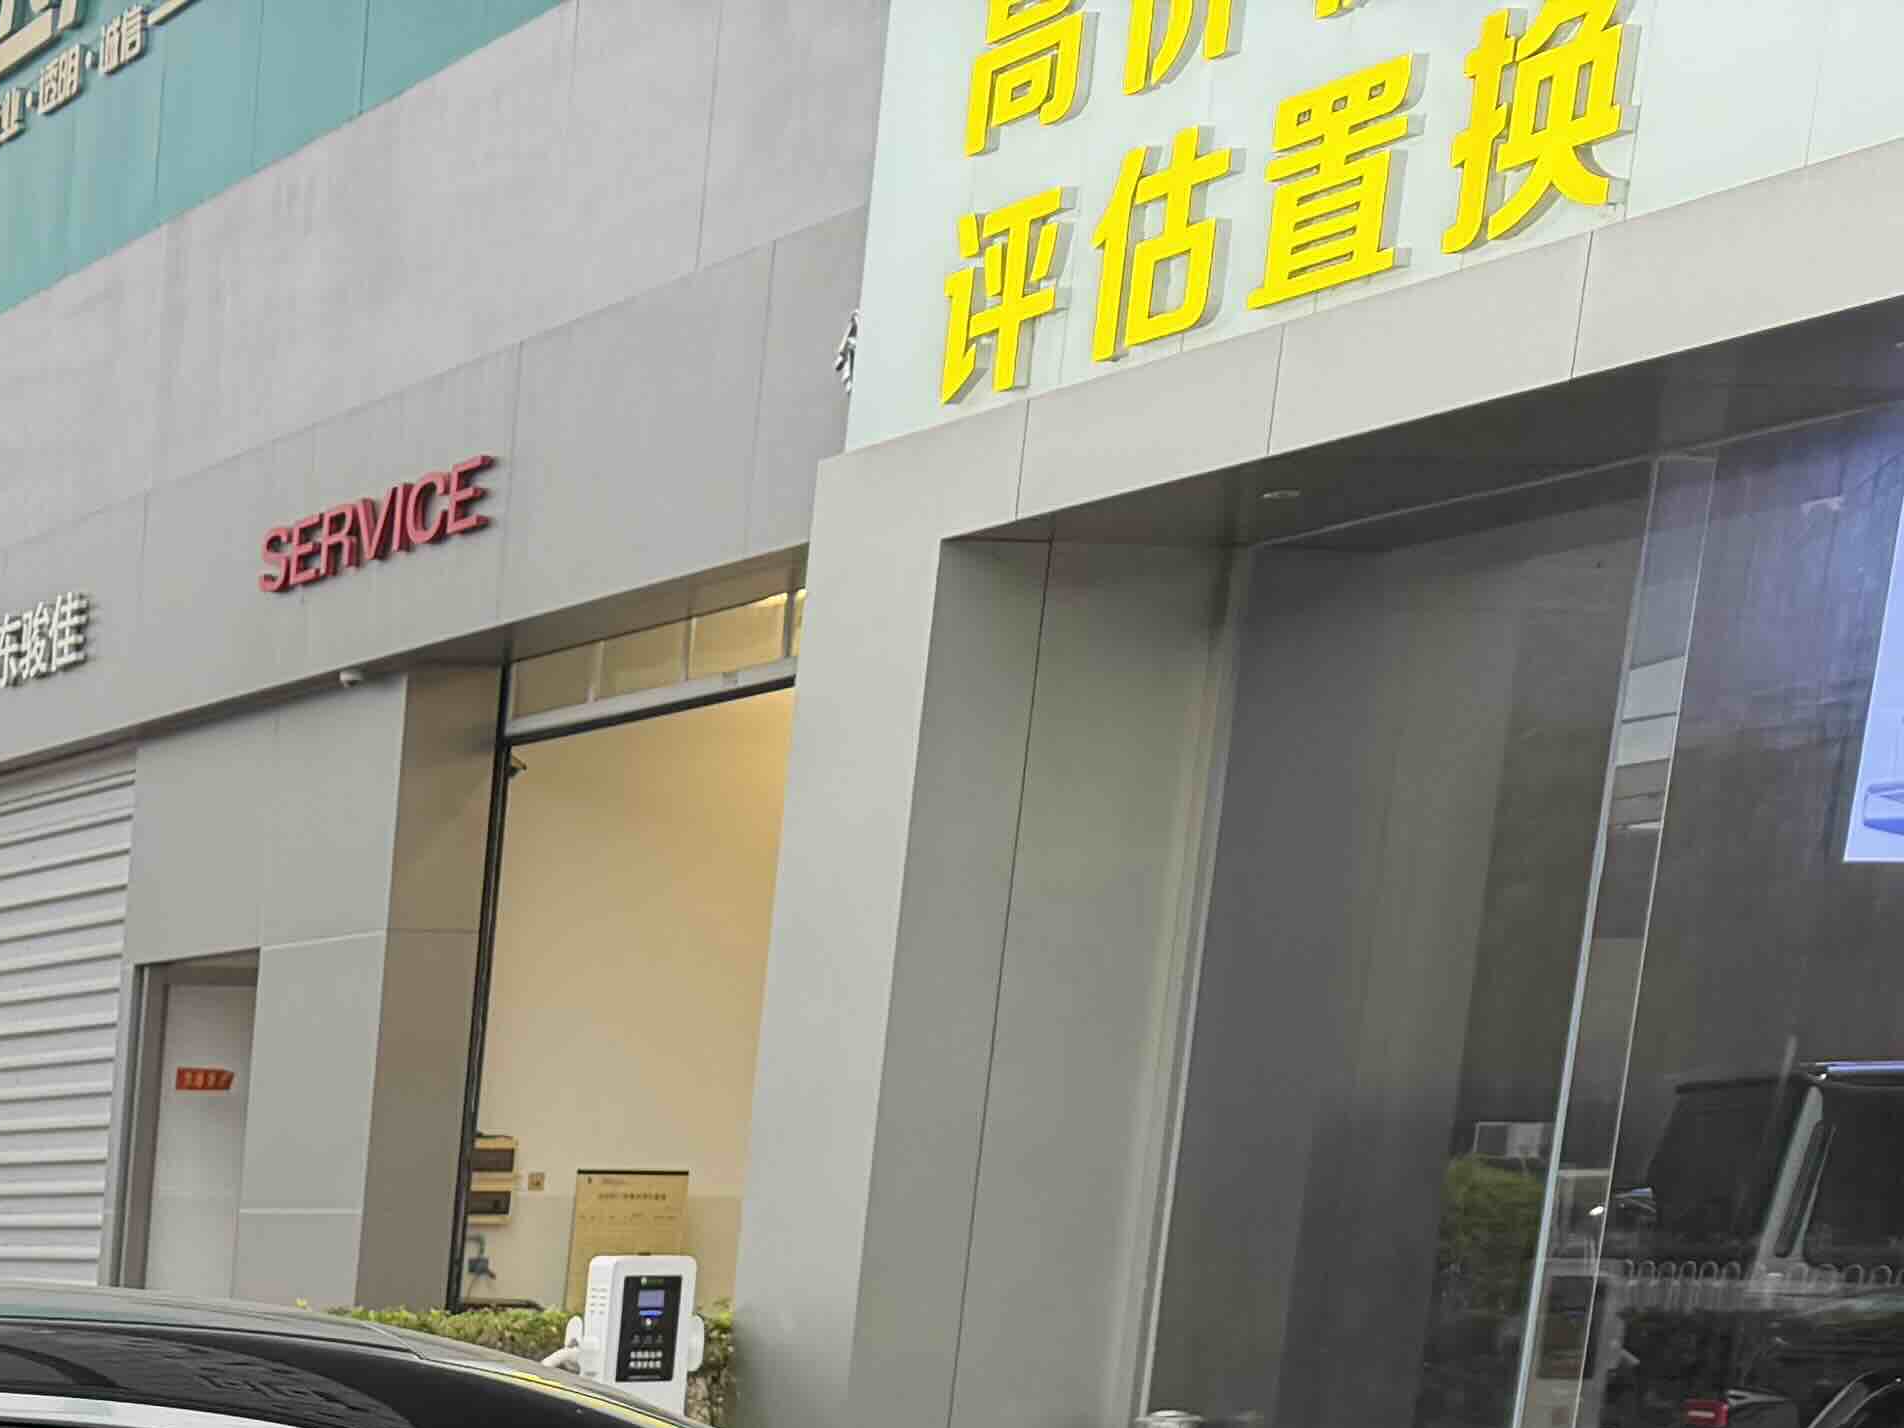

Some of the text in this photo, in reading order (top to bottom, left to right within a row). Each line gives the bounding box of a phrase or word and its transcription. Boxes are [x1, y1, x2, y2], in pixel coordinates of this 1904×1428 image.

[939, 0, 1624, 405] 评估置换
[258, 455, 495, 593] SERVICE
